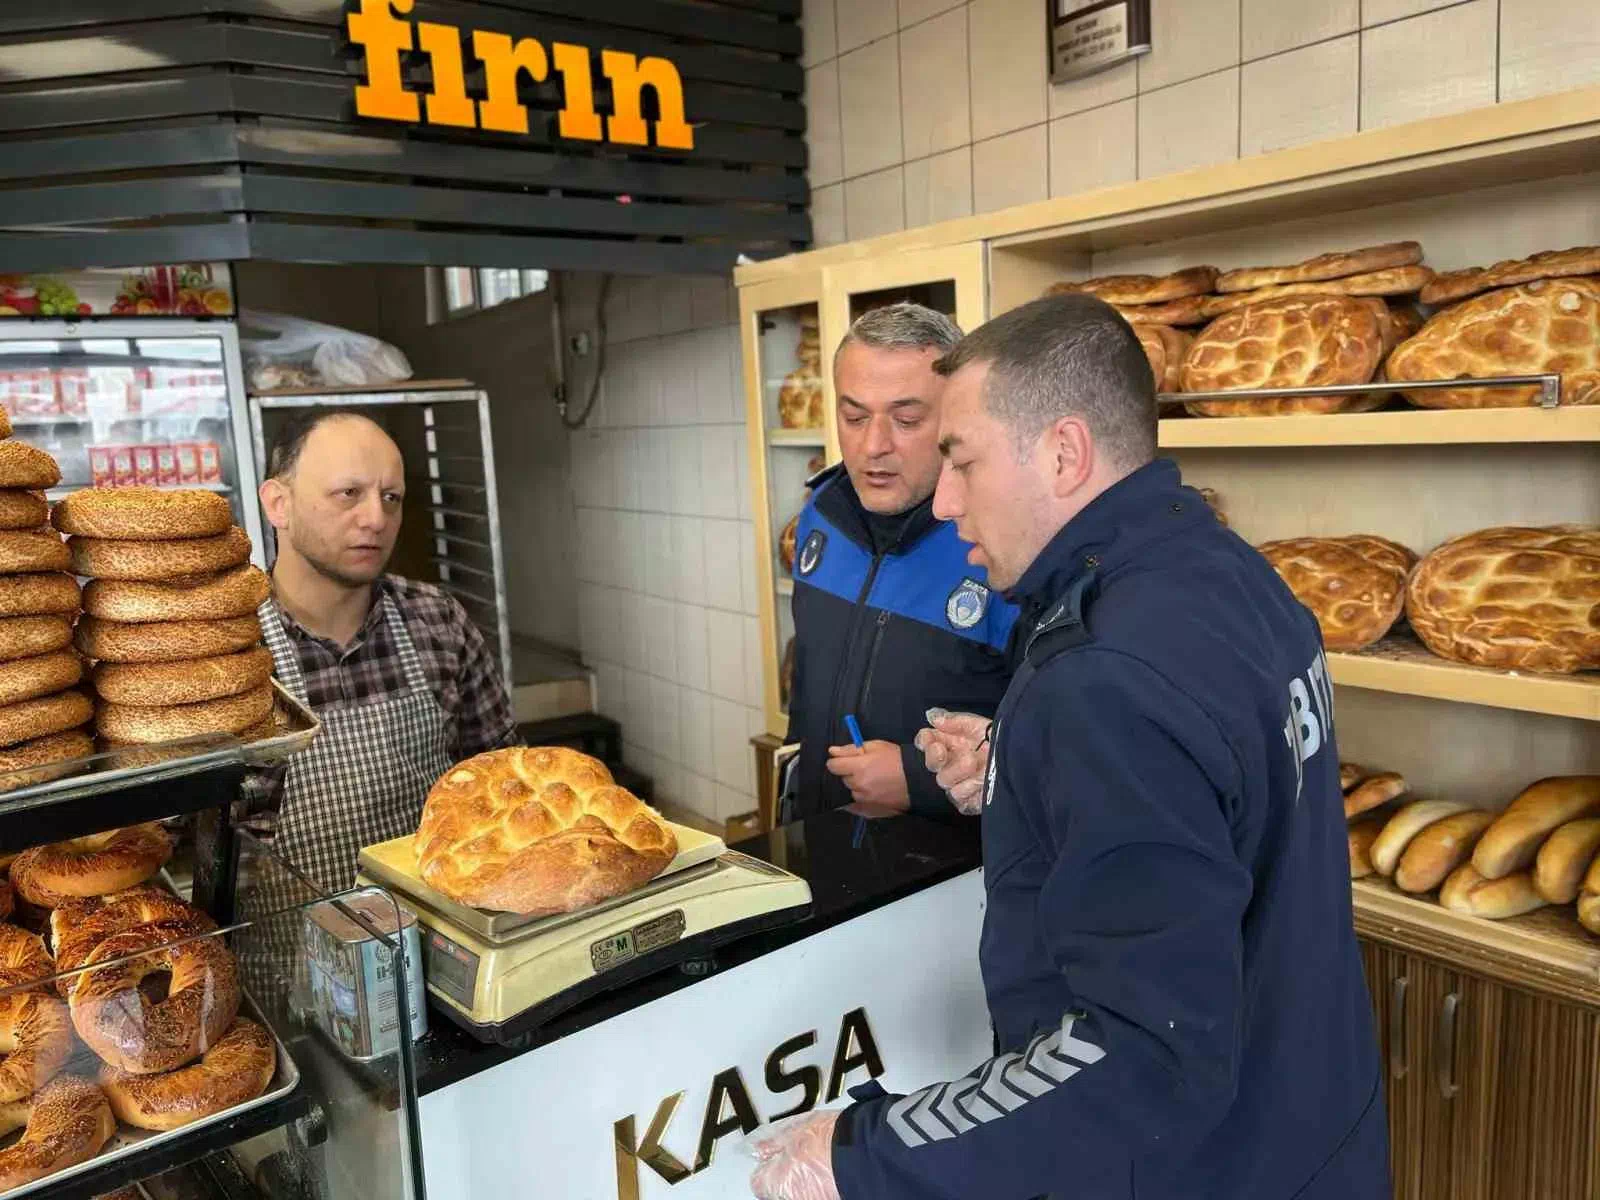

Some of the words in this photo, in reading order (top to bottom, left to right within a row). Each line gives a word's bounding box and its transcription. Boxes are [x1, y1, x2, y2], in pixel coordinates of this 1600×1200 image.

[348, 0, 694, 150] fırın
[616, 936, 627, 951] M
[613, 1005, 886, 1200] KASA
